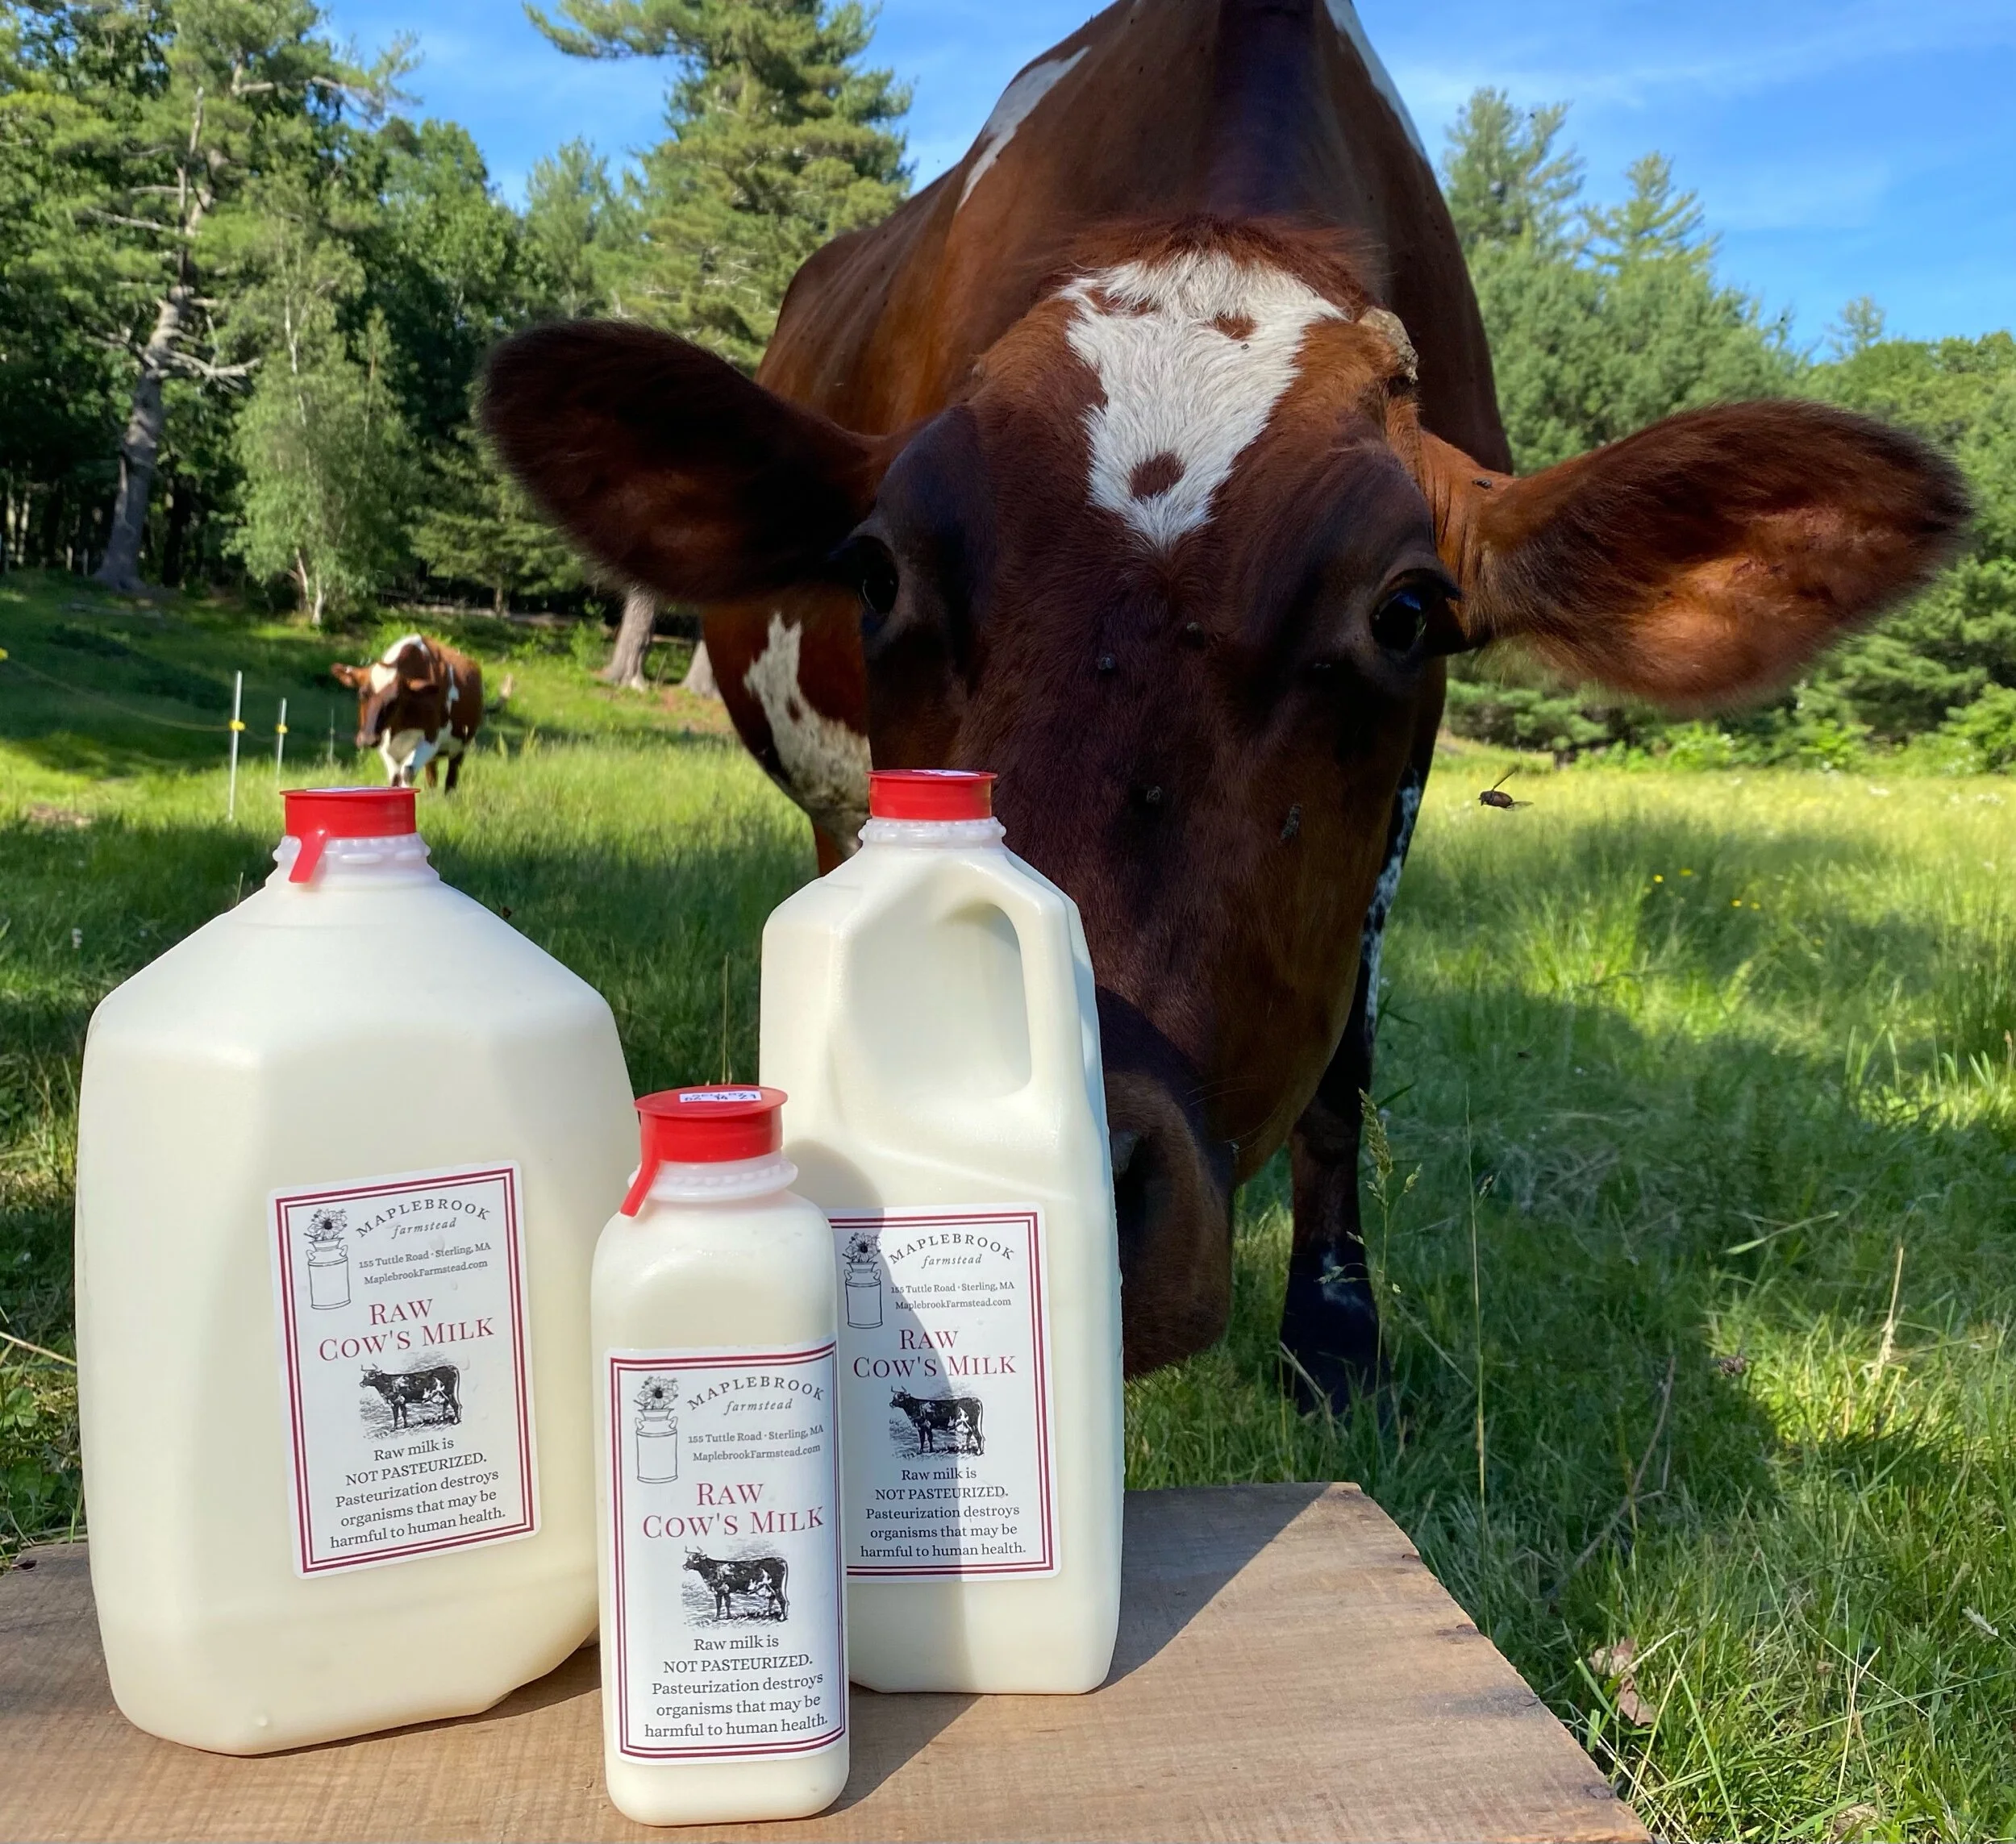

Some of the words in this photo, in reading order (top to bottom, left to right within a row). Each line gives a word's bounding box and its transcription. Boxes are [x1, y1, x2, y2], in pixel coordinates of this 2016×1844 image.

[356, 1199, 490, 1238] MAPLEBROOK
[391, 1218, 457, 1238] farmstead
[359, 1260, 374, 1268] 155
[375, 1255, 404, 1267] Tuttle
[406, 1251, 428, 1263] Road
[435, 1244, 473, 1258] Sterling,
[475, 1242, 491, 1252] MA
[889, 1234, 1014, 1264] MAPLEBROOK
[364, 1259, 488, 1284] MaplebrookFarmstead.com
[921, 1254, 982, 1268] farmstead
[906, 1285, 931, 1293] Tuttle
[934, 1284, 956, 1292] Road
[961, 1283, 998, 1292] Sterling,
[369, 1299, 433, 1326] RAW
[895, 1298, 1011, 1310] MaplebrookFarmstead.com
[319, 1330, 411, 1361] COW'S
[421, 1317, 494, 1347] MILK
[900, 1329, 958, 1350] RAW
[853, 1356, 937, 1377] COW'S
[948, 1355, 1016, 1376] MILK
[687, 1376, 824, 1410] MAPLEBROOK
[723, 1399, 793, 1416] farmstead
[688, 1435, 703, 1443] 155
[706, 1434, 735, 1443] Tuttle
[737, 1433, 761, 1442] Road
[768, 1429, 808, 1440] Sterling,
[810, 1425, 823, 1434] MA
[374, 1448, 404, 1461] Raw
[407, 1441, 439, 1455] milk
[443, 1438, 454, 1449] is
[693, 1445, 821, 1462] MaplebrookFarmstead.com
[346, 1471, 378, 1486] NOT
[381, 1452, 487, 1480] PASTEURIZED.
[902, 1470, 930, 1480] Raw
[933, 1467, 963, 1480] milk
[966, 1467, 977, 1478] is
[335, 1482, 437, 1507] Pasteurization
[441, 1470, 499, 1490] destroys
[697, 1484, 764, 1506] RAW
[876, 1489, 906, 1501] NOT
[909, 1486, 1008, 1499] PASTEURIZED.
[340, 1506, 413, 1527] organisms
[417, 1501, 444, 1513] that
[448, 1496, 477, 1509] may
[480, 1491, 497, 1501] be
[866, 1508, 960, 1519] Pasteurization
[964, 1505, 1019, 1517] destroys
[331, 1528, 387, 1548] harmful
[391, 1527, 405, 1537] to
[407, 1519, 456, 1534] human
[460, 1509, 506, 1526] health.
[644, 1513, 738, 1538] COW'S
[750, 1506, 824, 1534] MILK
[871, 1528, 937, 1540] organisms
[940, 1526, 966, 1537] that
[970, 1526, 999, 1538] may
[1002, 1524, 1017, 1534] be
[860, 1546, 912, 1557] harmful
[916, 1546, 929, 1556] to
[932, 1544, 978, 1556] human
[981, 1542, 1026, 1554] health.
[694, 1638, 727, 1650] Raw
[729, 1635, 764, 1649] milk
[766, 1635, 779, 1647] is
[663, 1661, 698, 1673] NOT
[702, 1655, 813, 1671] PASTEURIZED.
[652, 1680, 759, 1695] Pasteurization
[763, 1674, 823, 1690] destroys
[656, 1703, 732, 1719] organisms
[736, 1700, 766, 1713] that
[769, 1700, 802, 1713] may
[805, 1695, 821, 1708] be
[645, 1724, 703, 1738] harmful
[708, 1725, 723, 1735] to
[726, 1722, 778, 1735] human
[781, 1714, 827, 1732] health.
